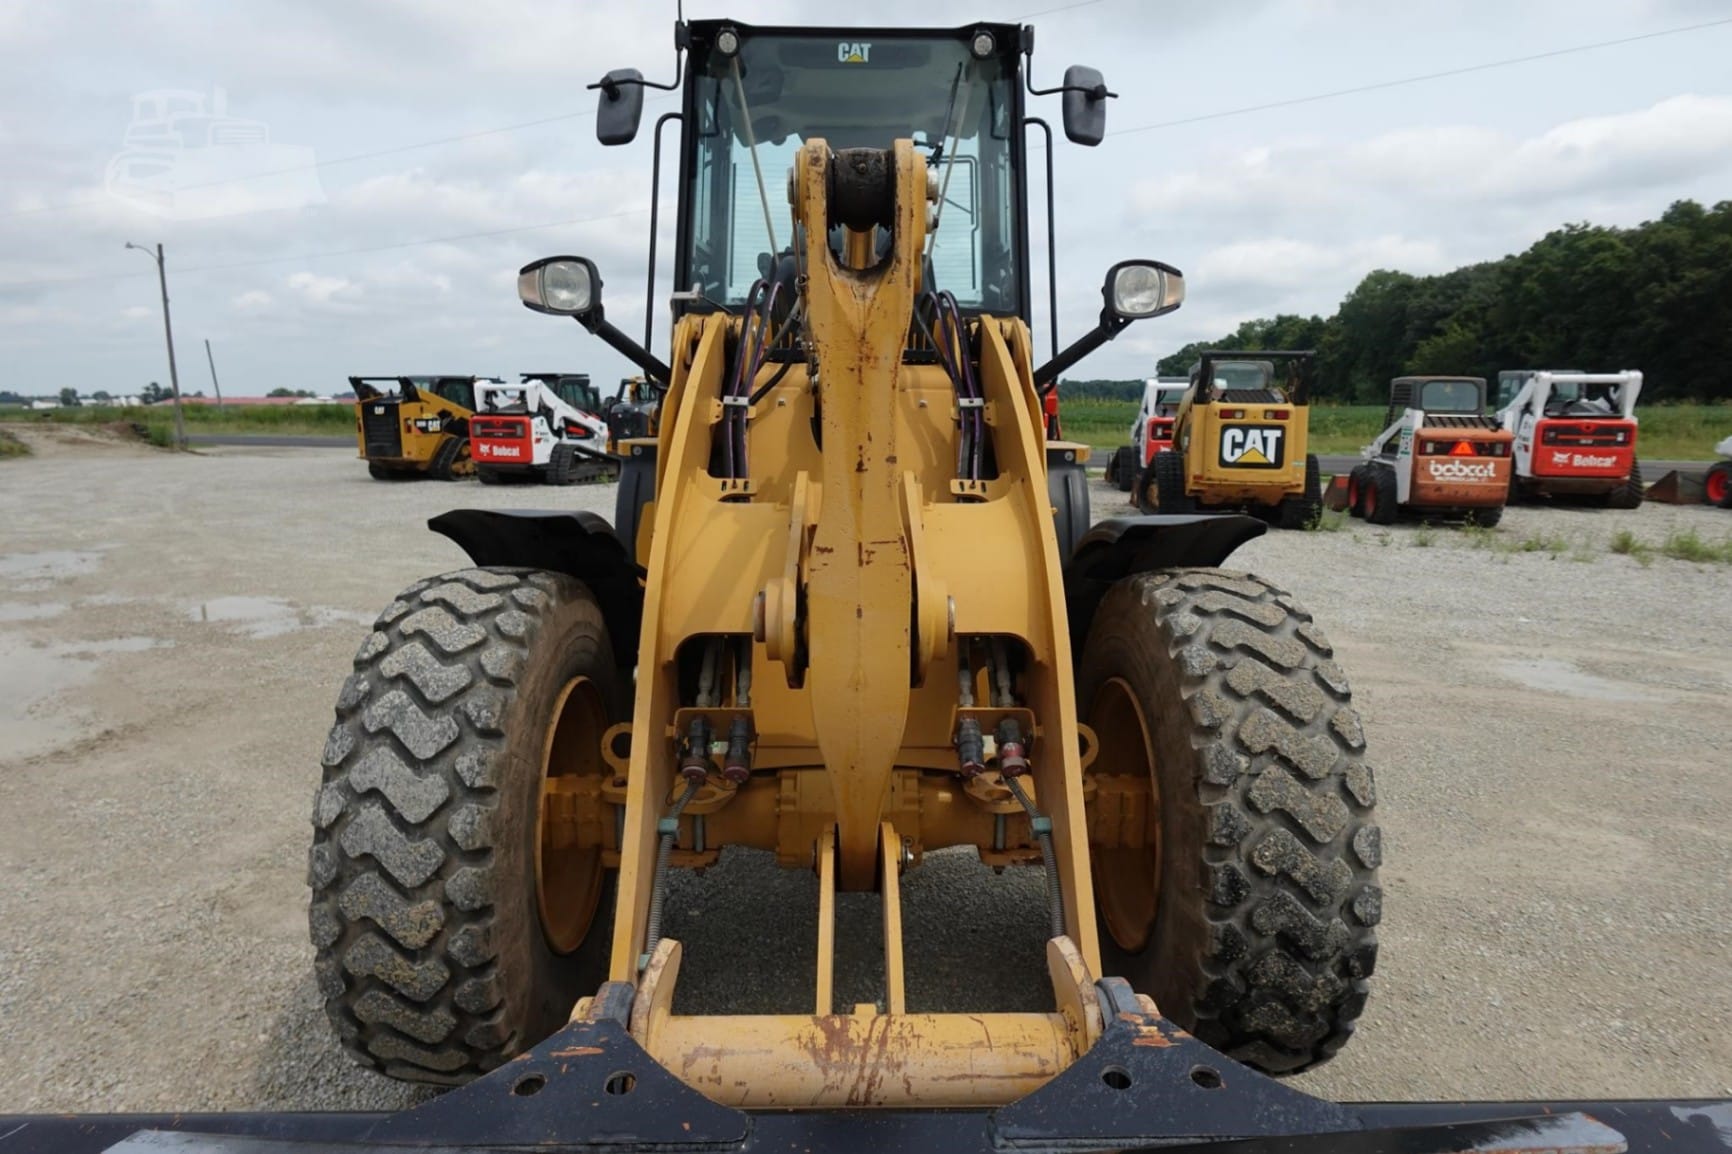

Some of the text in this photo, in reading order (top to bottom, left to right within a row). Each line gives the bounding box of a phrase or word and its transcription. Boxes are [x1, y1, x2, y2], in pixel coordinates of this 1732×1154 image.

[837, 42, 872, 62] CAT
[492, 444, 520, 457] Bobcat
[1222, 427, 1282, 464] CAT
[1429, 460, 1496, 478] bobcat
[1573, 454, 1617, 468] Bobcat
